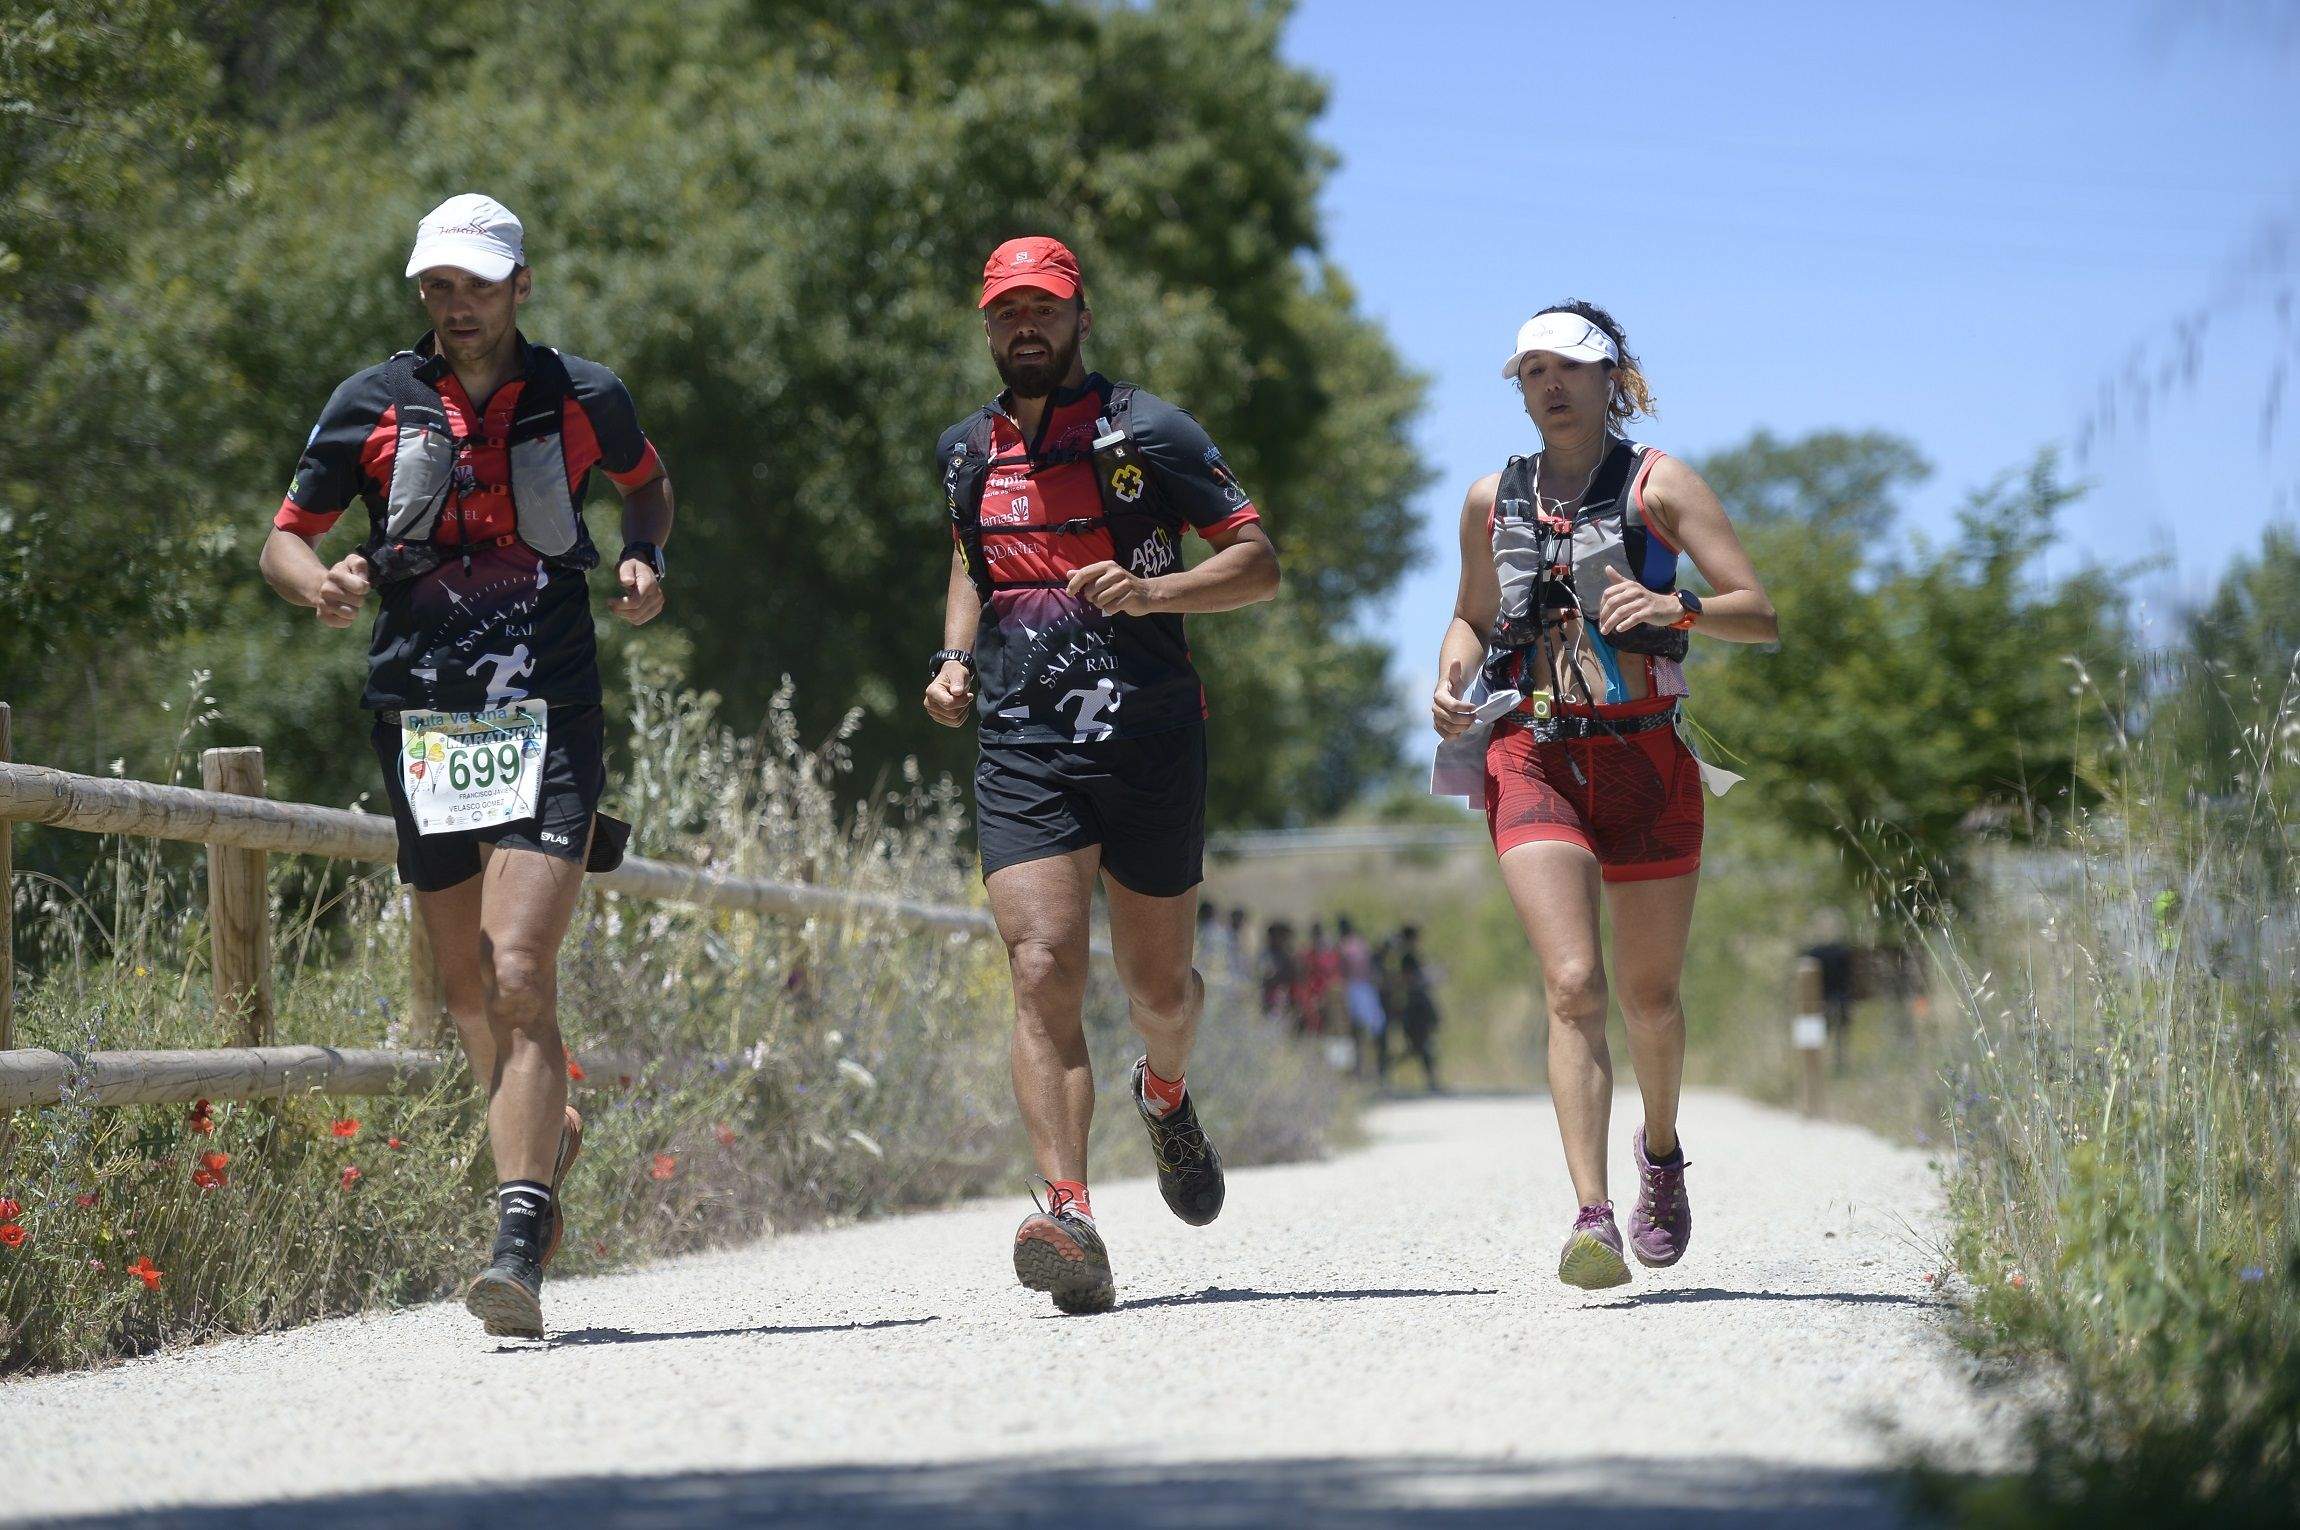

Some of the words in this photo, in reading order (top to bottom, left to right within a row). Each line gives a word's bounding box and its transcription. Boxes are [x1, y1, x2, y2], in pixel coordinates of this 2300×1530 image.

[408, 713, 444, 732] Ruta
[451, 708, 507, 724] Veona
[449, 743, 520, 791] 699
[459, 790, 493, 800] FRANCISCO
[448, 802, 481, 813] VELASCO
[481, 798, 506, 809] GOMEZ
